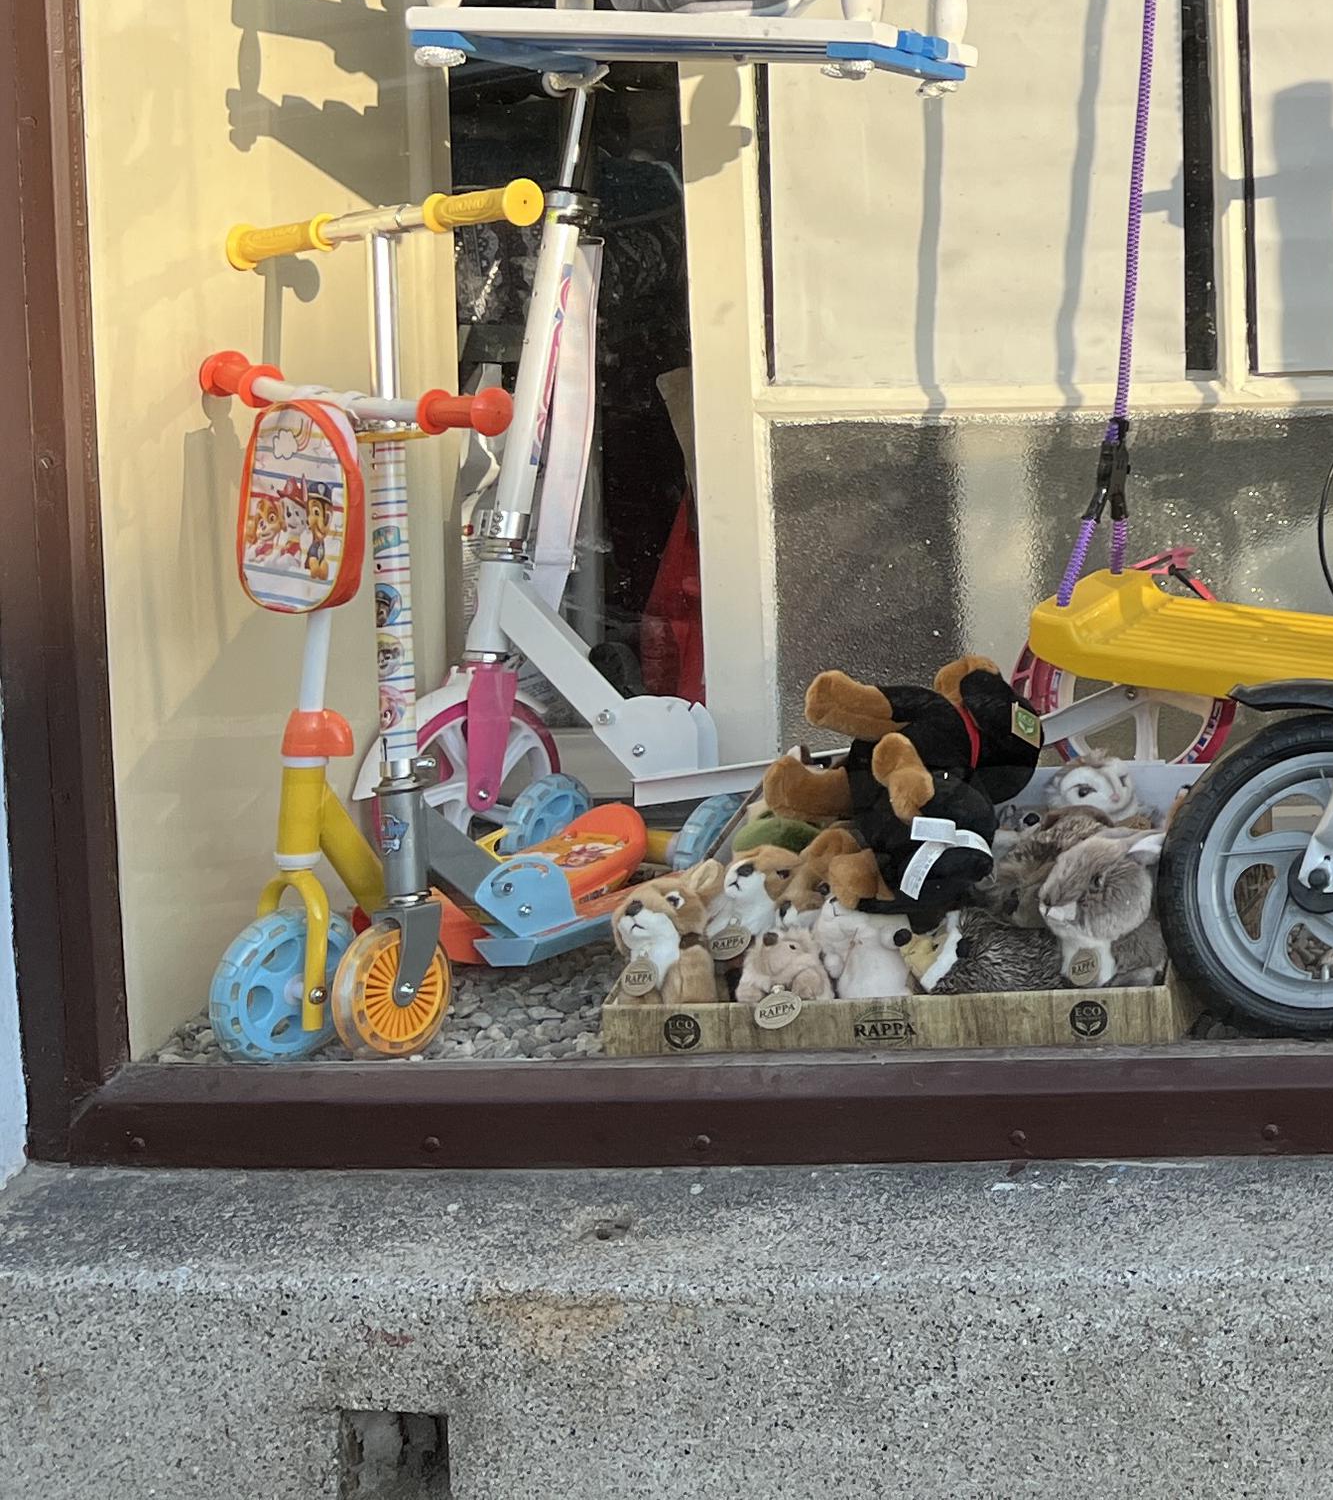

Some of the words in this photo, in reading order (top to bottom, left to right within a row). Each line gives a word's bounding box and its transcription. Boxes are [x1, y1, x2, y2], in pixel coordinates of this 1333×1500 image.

[624, 973, 653, 984] RAPPA
[758, 1002, 797, 1019] RAPPA
[1074, 1006, 1102, 1017] ECO
[854, 1022, 918, 1038] RAPPA
